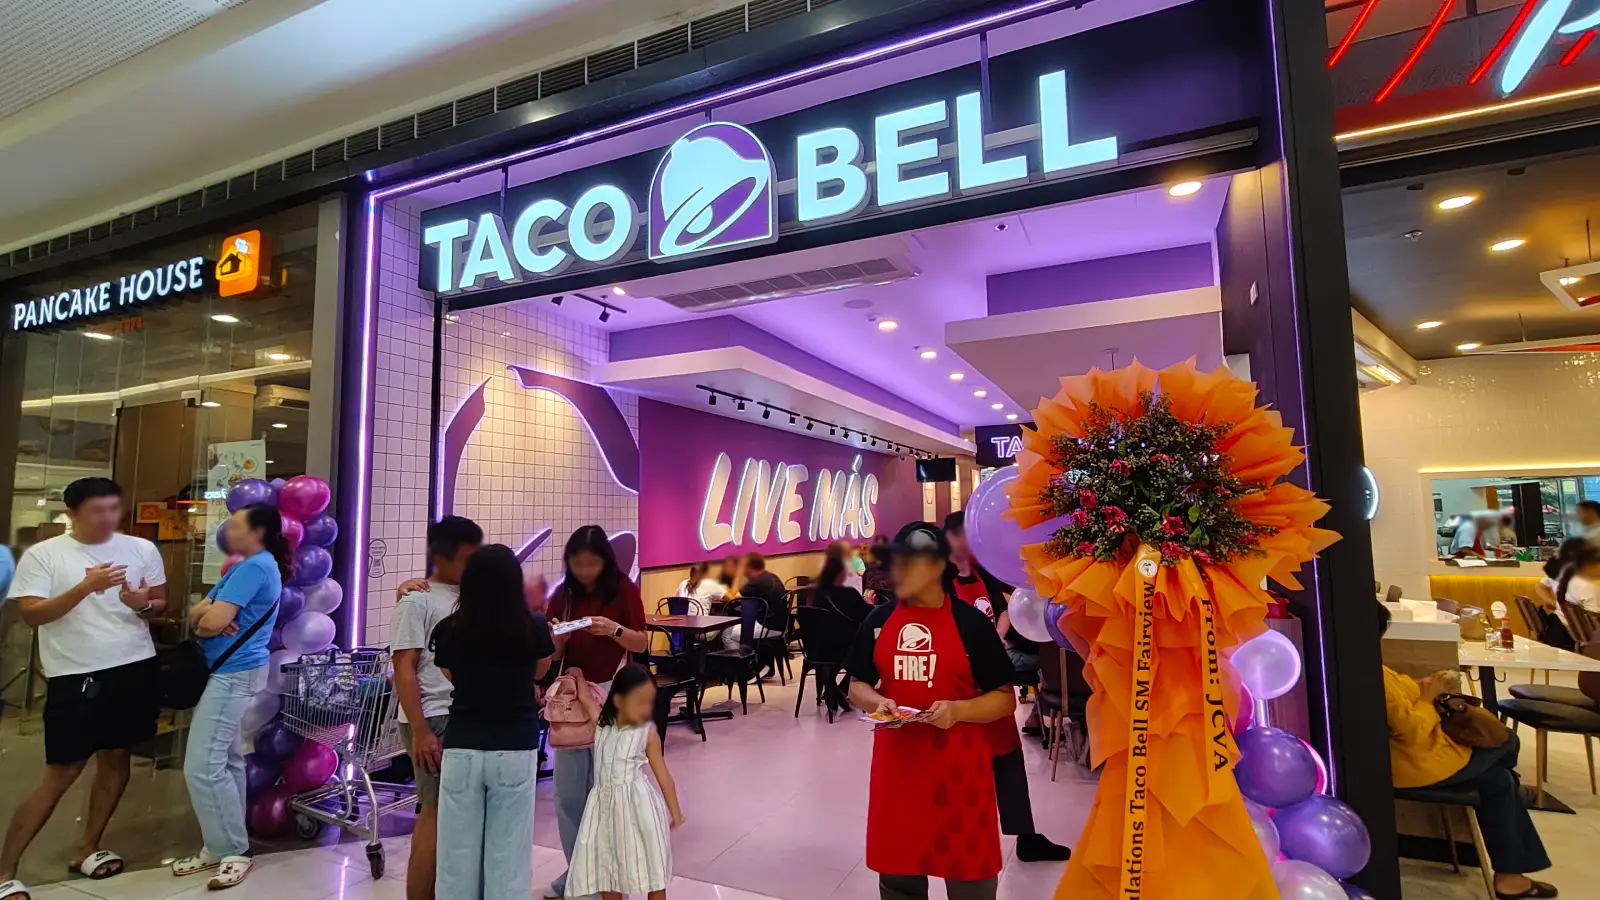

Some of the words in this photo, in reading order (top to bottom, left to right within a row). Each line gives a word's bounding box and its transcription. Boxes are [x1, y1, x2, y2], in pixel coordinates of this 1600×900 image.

[424, 184, 634, 292] TACO
[797, 69, 1119, 222] BELL
[13, 281, 111, 331] PANCAKE
[119, 256, 204, 306] HOUSE
[700, 451, 809, 551] LIVE
[808, 454, 879, 542] MÁS
[1136, 581, 1156, 673] Fairview
[1201, 598, 1220, 685] From:
[894, 653, 937, 689] FIRE!
[1135, 679, 1150, 711] SM
[1132, 719, 1149, 757] Bell
[1205, 693, 1229, 772] JCVA
[1130, 765, 1147, 814] Taco
[1124, 820, 1144, 900] lations
